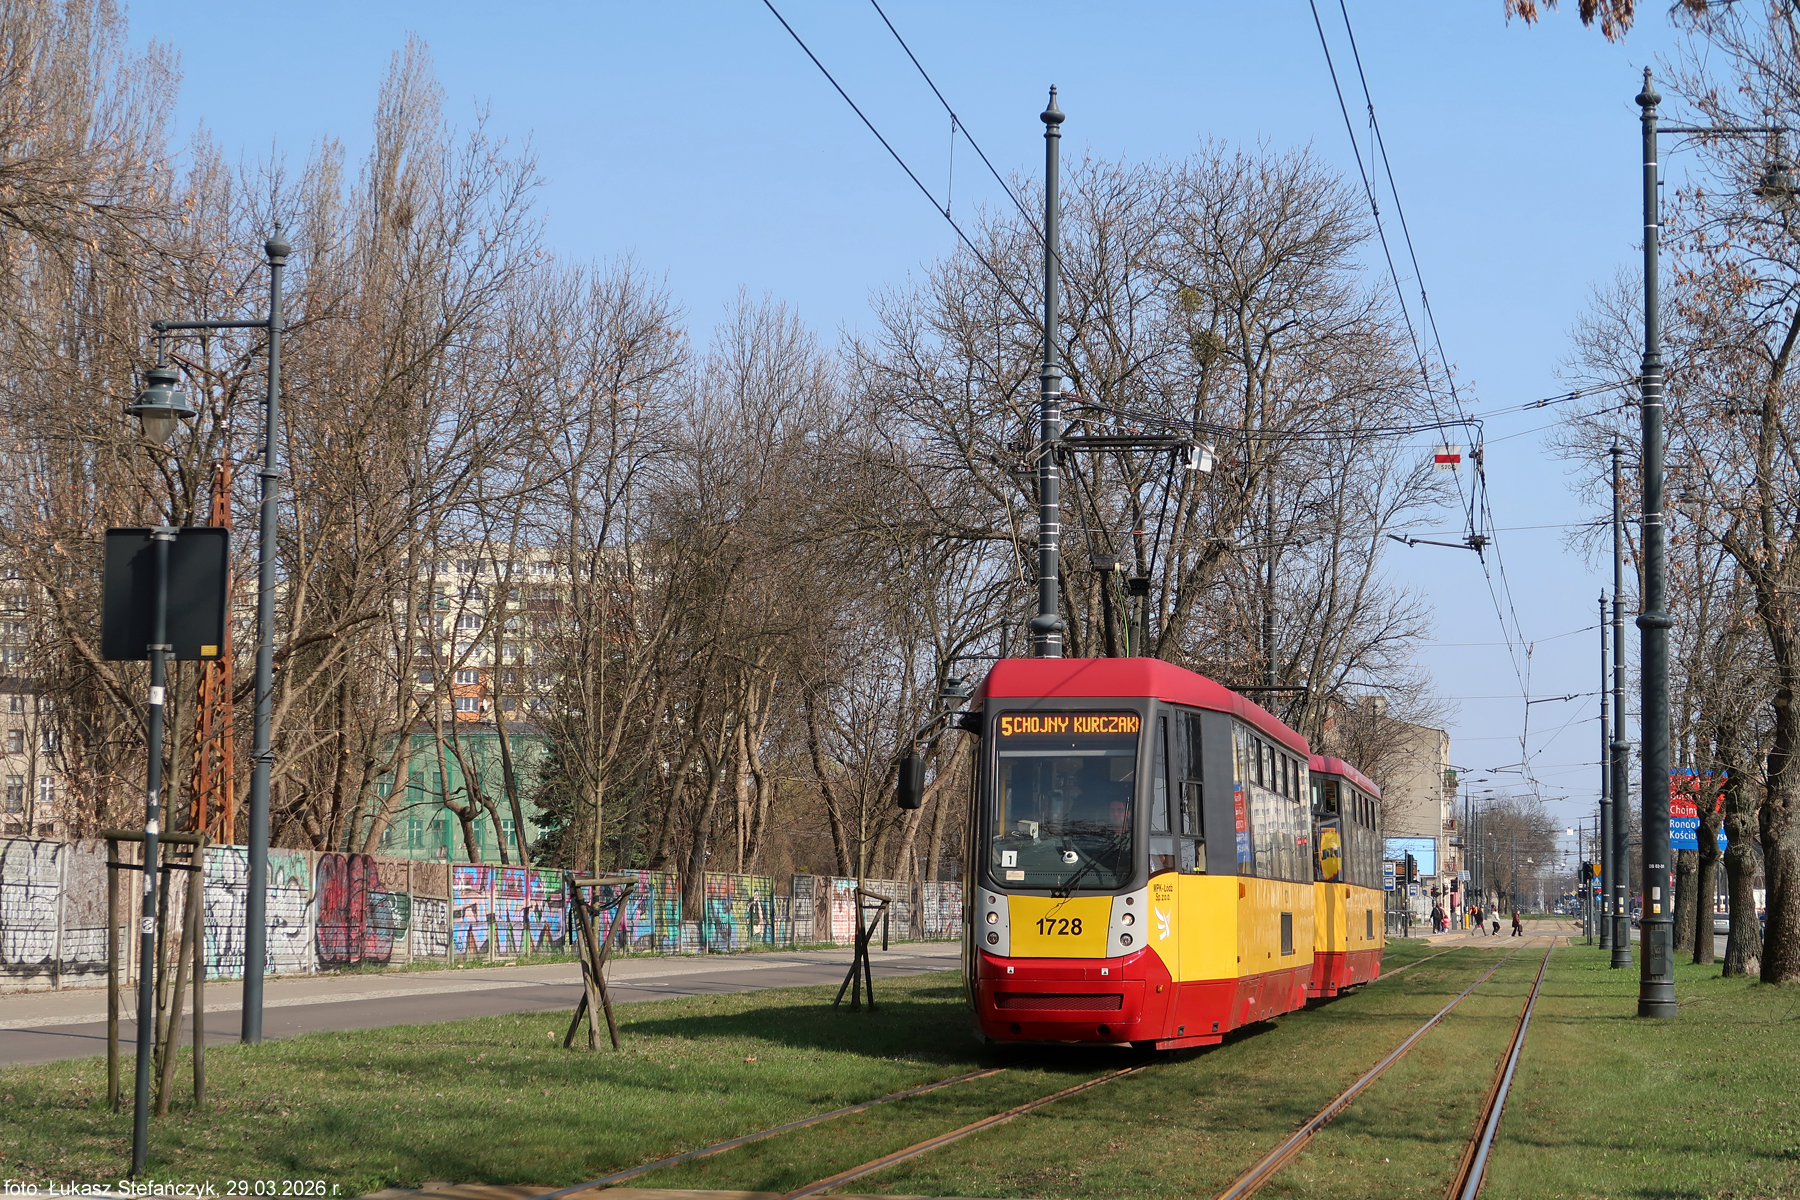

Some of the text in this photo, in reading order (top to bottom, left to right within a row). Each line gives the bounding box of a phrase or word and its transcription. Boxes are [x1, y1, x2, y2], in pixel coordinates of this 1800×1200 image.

[1001, 716, 1013, 736] 5
[1013, 716, 1069, 733] CHOJNY
[1670, 805, 1697, 817] Chojny
[1670, 819, 1696, 829] Rondo
[1008, 855, 1013, 865] 1
[1036, 918, 1082, 936] 1728
